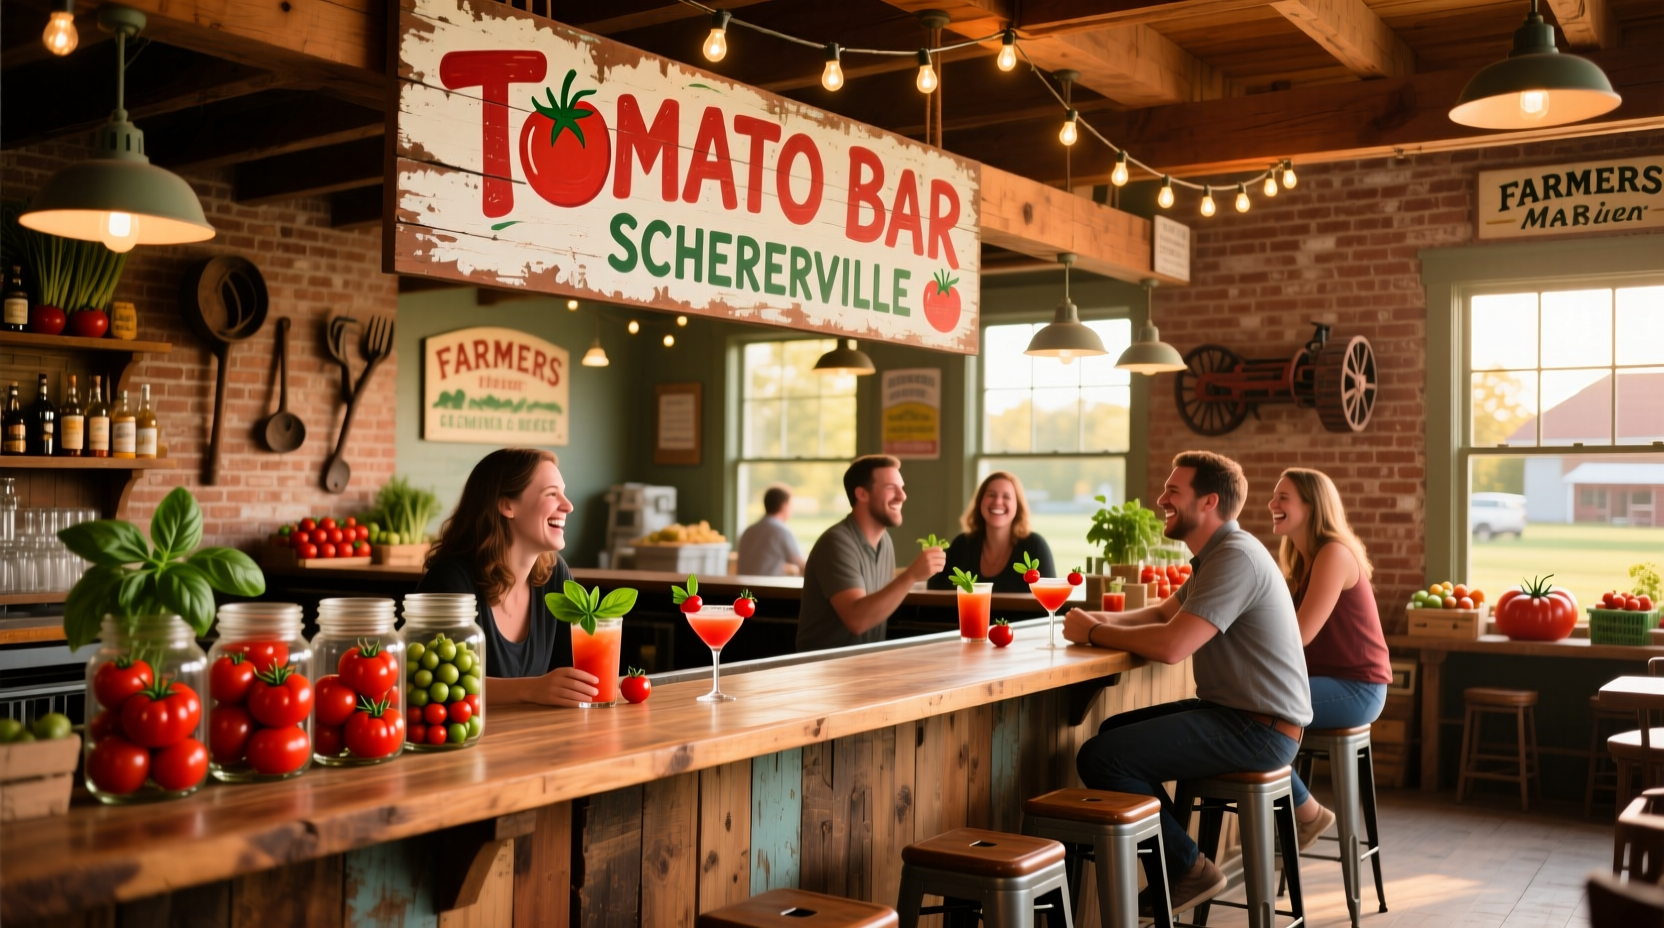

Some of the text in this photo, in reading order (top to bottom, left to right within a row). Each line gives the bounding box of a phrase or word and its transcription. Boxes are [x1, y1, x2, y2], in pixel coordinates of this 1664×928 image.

[440, 50, 960, 270] TOMATO BAR
[1498, 165, 1663, 213] FARMERS
[607, 212, 911, 318] SCHERERVILLE
[435, 339, 562, 387] FARMERS
